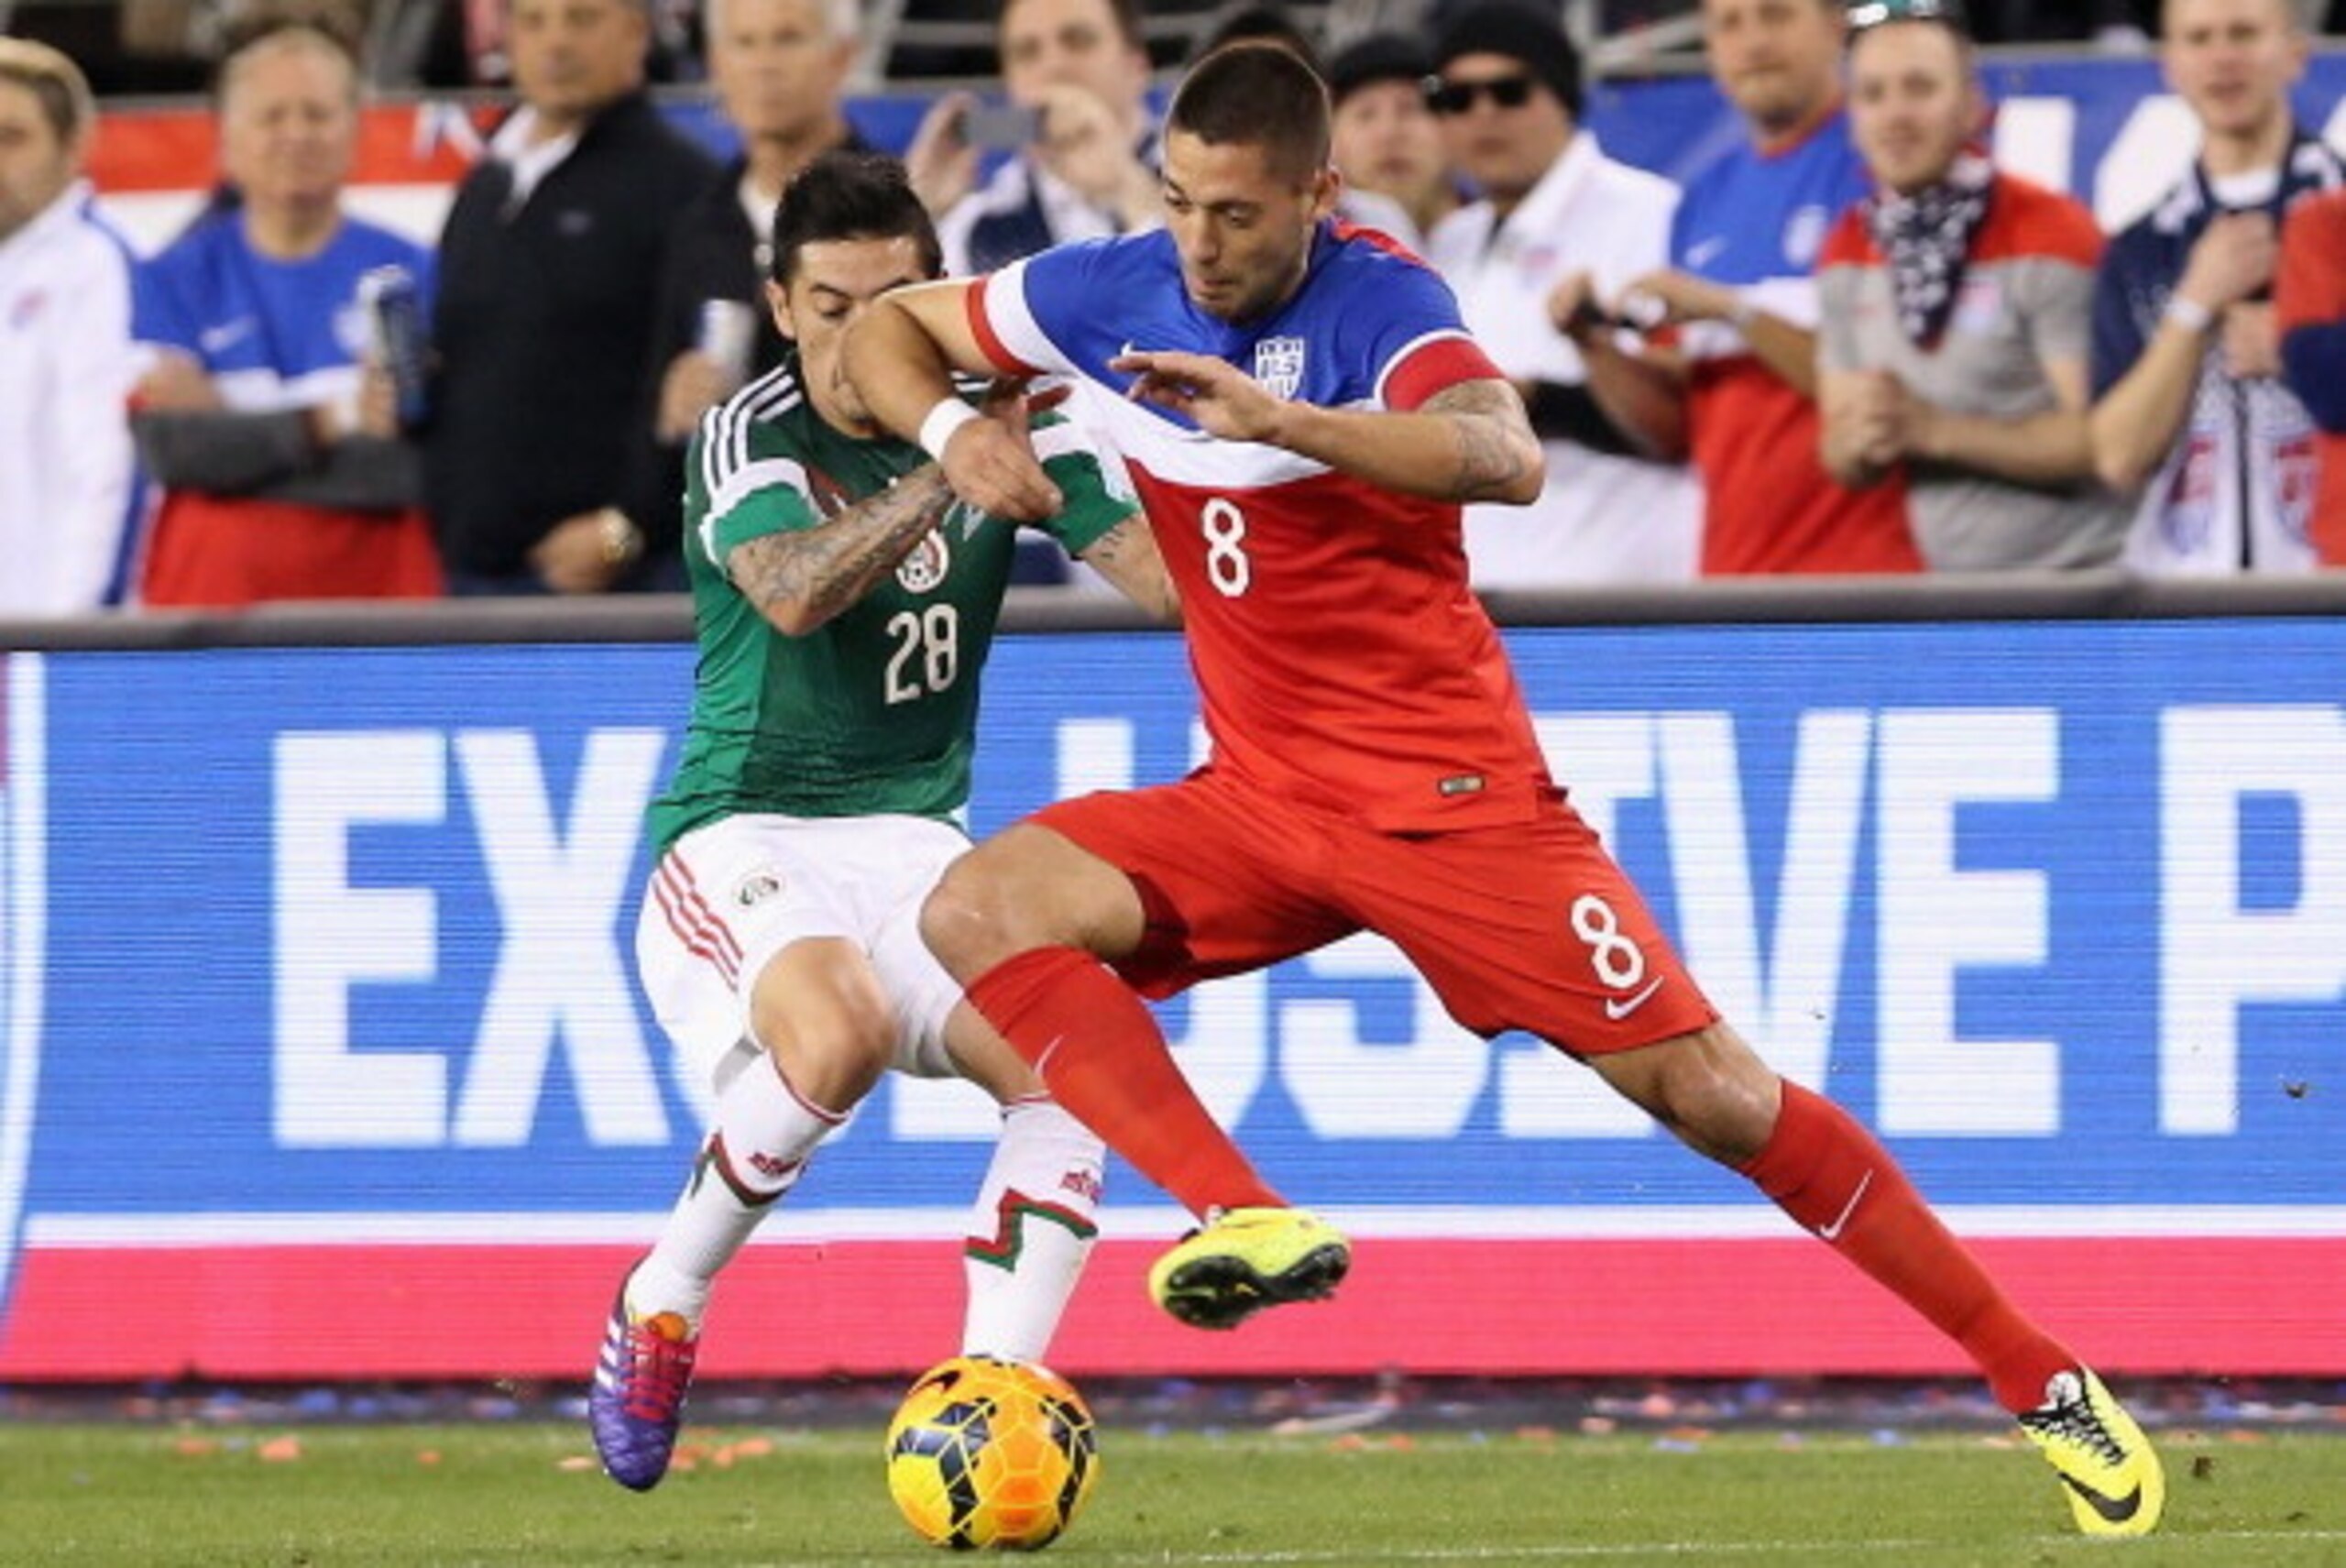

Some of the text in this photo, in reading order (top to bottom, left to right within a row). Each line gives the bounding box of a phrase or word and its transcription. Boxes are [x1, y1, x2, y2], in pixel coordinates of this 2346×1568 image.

[1202, 498, 1248, 598] 8
[885, 603, 958, 704] 28
[1571, 894, 1644, 989] 8
